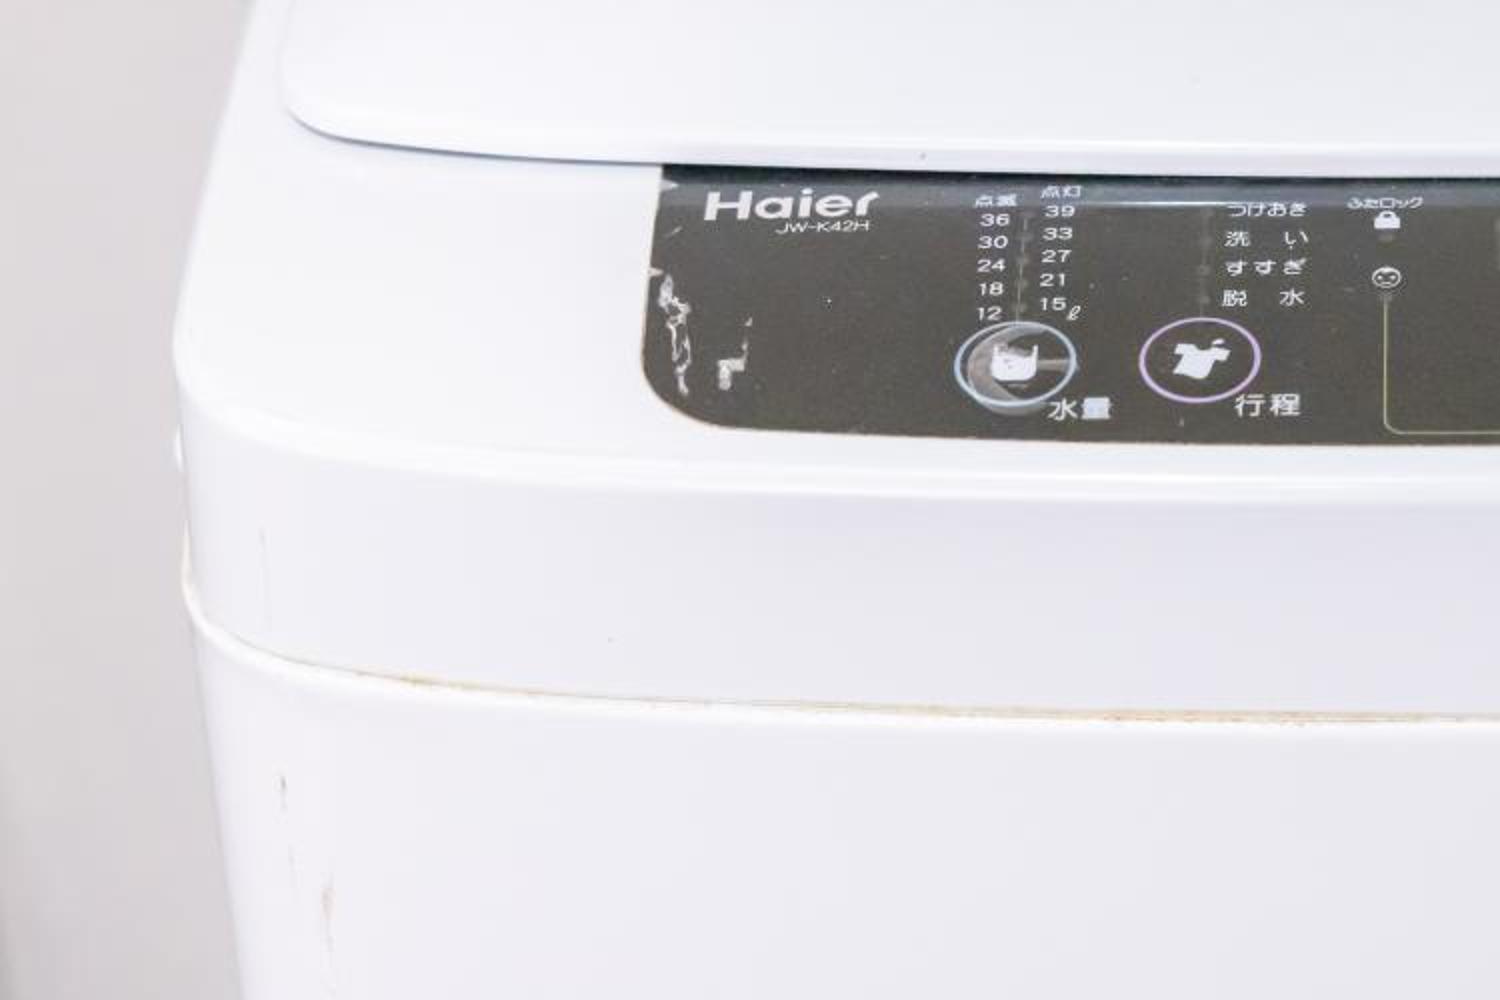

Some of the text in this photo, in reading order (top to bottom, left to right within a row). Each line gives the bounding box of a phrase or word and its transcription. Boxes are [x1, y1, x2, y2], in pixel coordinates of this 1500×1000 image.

[703, 188, 879, 221] Haier
[1044, 205, 1075, 217] 39
[1227, 201, 1307, 217] つけおき
[775, 219, 870, 233] JW-K42H
[979, 213, 1010, 227] 36
[1042, 227, 1073, 240] 33
[977, 235, 1009, 249] 30
[1041, 249, 1072, 263] 27
[977, 258, 1006, 273] 24
[1040, 273, 1066, 287] 21
[979, 282, 1004, 296] 18
[976, 306, 1002, 321] 12
[1048, 397, 1111, 421] 水量
[1235, 393, 1302, 417] 行程
